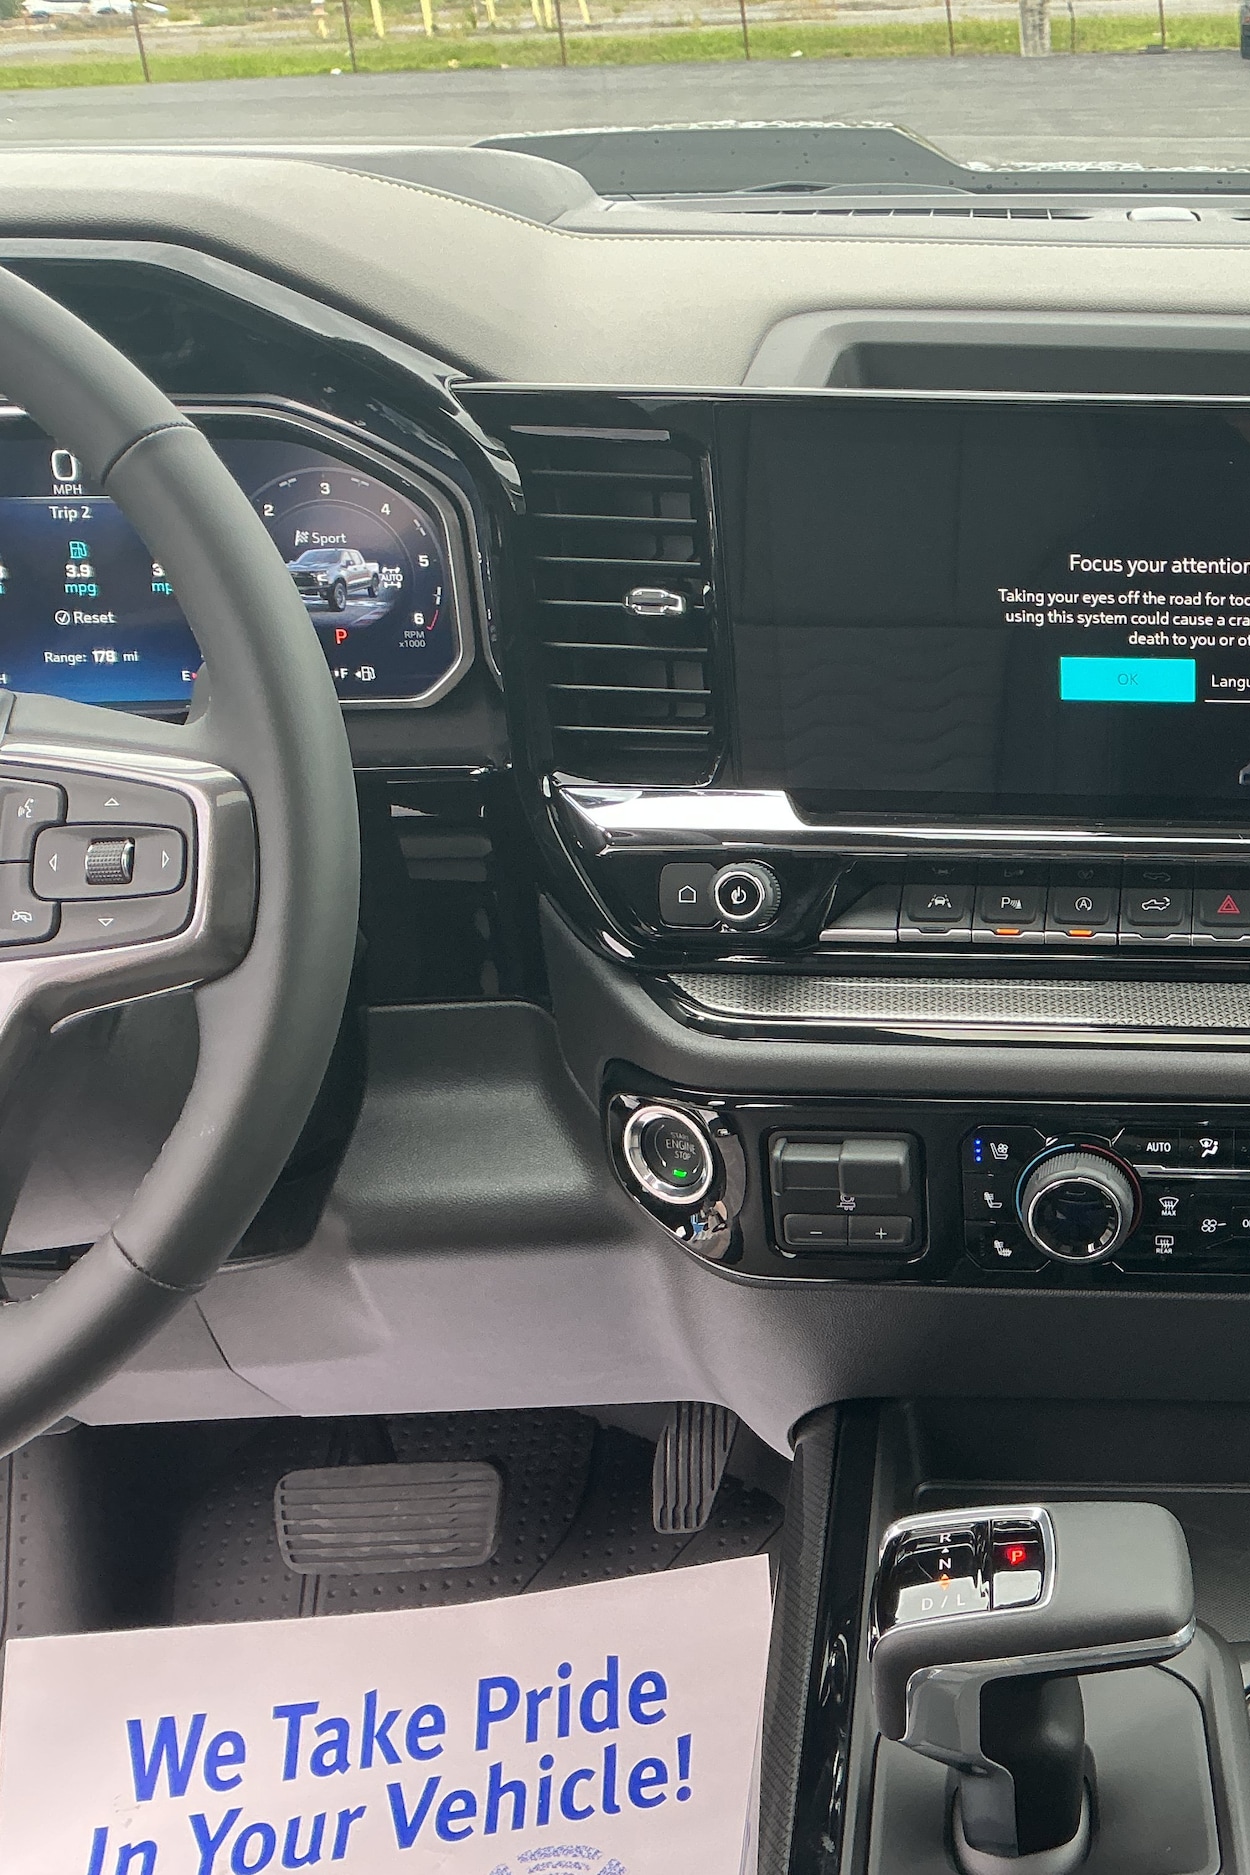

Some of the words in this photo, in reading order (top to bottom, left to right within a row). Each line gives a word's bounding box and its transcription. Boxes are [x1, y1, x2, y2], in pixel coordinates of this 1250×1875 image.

[51, 450, 76, 480] 0
[53, 485, 82, 495] MPH
[320, 482, 331, 494] 3
[49, 506, 78, 522] Trip
[82, 506, 91, 518] 2
[263, 504, 274, 516] 2
[381, 503, 391, 515] 4
[312, 533, 346, 546] Sport
[419, 555, 429, 566] 5
[1069, 554, 1123, 572] Focus
[1127, 559, 1167, 577] your
[65, 564, 92, 577] 3.9
[152, 563, 165, 577] 3.
[65, 583, 97, 596] mpg
[152, 582, 173, 594] mp
[998, 588, 1044, 606] Taking
[1047, 592, 1079, 606] your
[1083, 593, 1115, 607] eyes
[1118, 591, 1140, 604] off
[1143, 591, 1166, 605] the
[1170, 592, 1201, 605] road
[1205, 592, 1226, 606] for
[74, 612, 116, 623] Reset
[414, 613, 424, 624] 6
[1006, 611, 1044, 626] using
[1047, 609, 1074, 623] this
[1077, 613, 1127, 627] system
[1131, 612, 1169, 625] could
[1173, 614, 1213, 626] cause
[1217, 616, 1225, 626] a
[336, 629, 347, 644] P
[1129, 631, 1169, 644] death
[1172, 634, 1187, 645] to
[1190, 635, 1215, 649] you
[1219, 635, 1235, 646] or
[399, 640, 425, 648] x1000
[44, 652, 86, 665] Range:
[92, 650, 116, 662] 178
[123, 651, 138, 662] mi
[182, 671, 191, 681] E
[341, 668, 348, 678] F
[1117, 673, 1138, 686] OK
[666, 1139, 696, 1155] ENGINE
[1146, 1142, 1171, 1153] AUTO
[674, 1151, 691, 1160] STOP
[1161, 1208, 1176, 1216] MAX
[1156, 1246, 1173, 1254] REAR
[940, 1533, 951, 1543] R
[1011, 1551, 1023, 1563] P
[939, 1558, 951, 1570] N
[922, 1598, 934, 1611] D
[956, 1594, 966, 1606] L
[127, 1713, 245, 1802] We
[273, 1689, 446, 1782] Take
[475, 1655, 668, 1752] Pride
[86, 1826, 157, 1875] In
[189, 1805, 367, 1875] Your
[387, 1733, 693, 1851] Vehicle!
